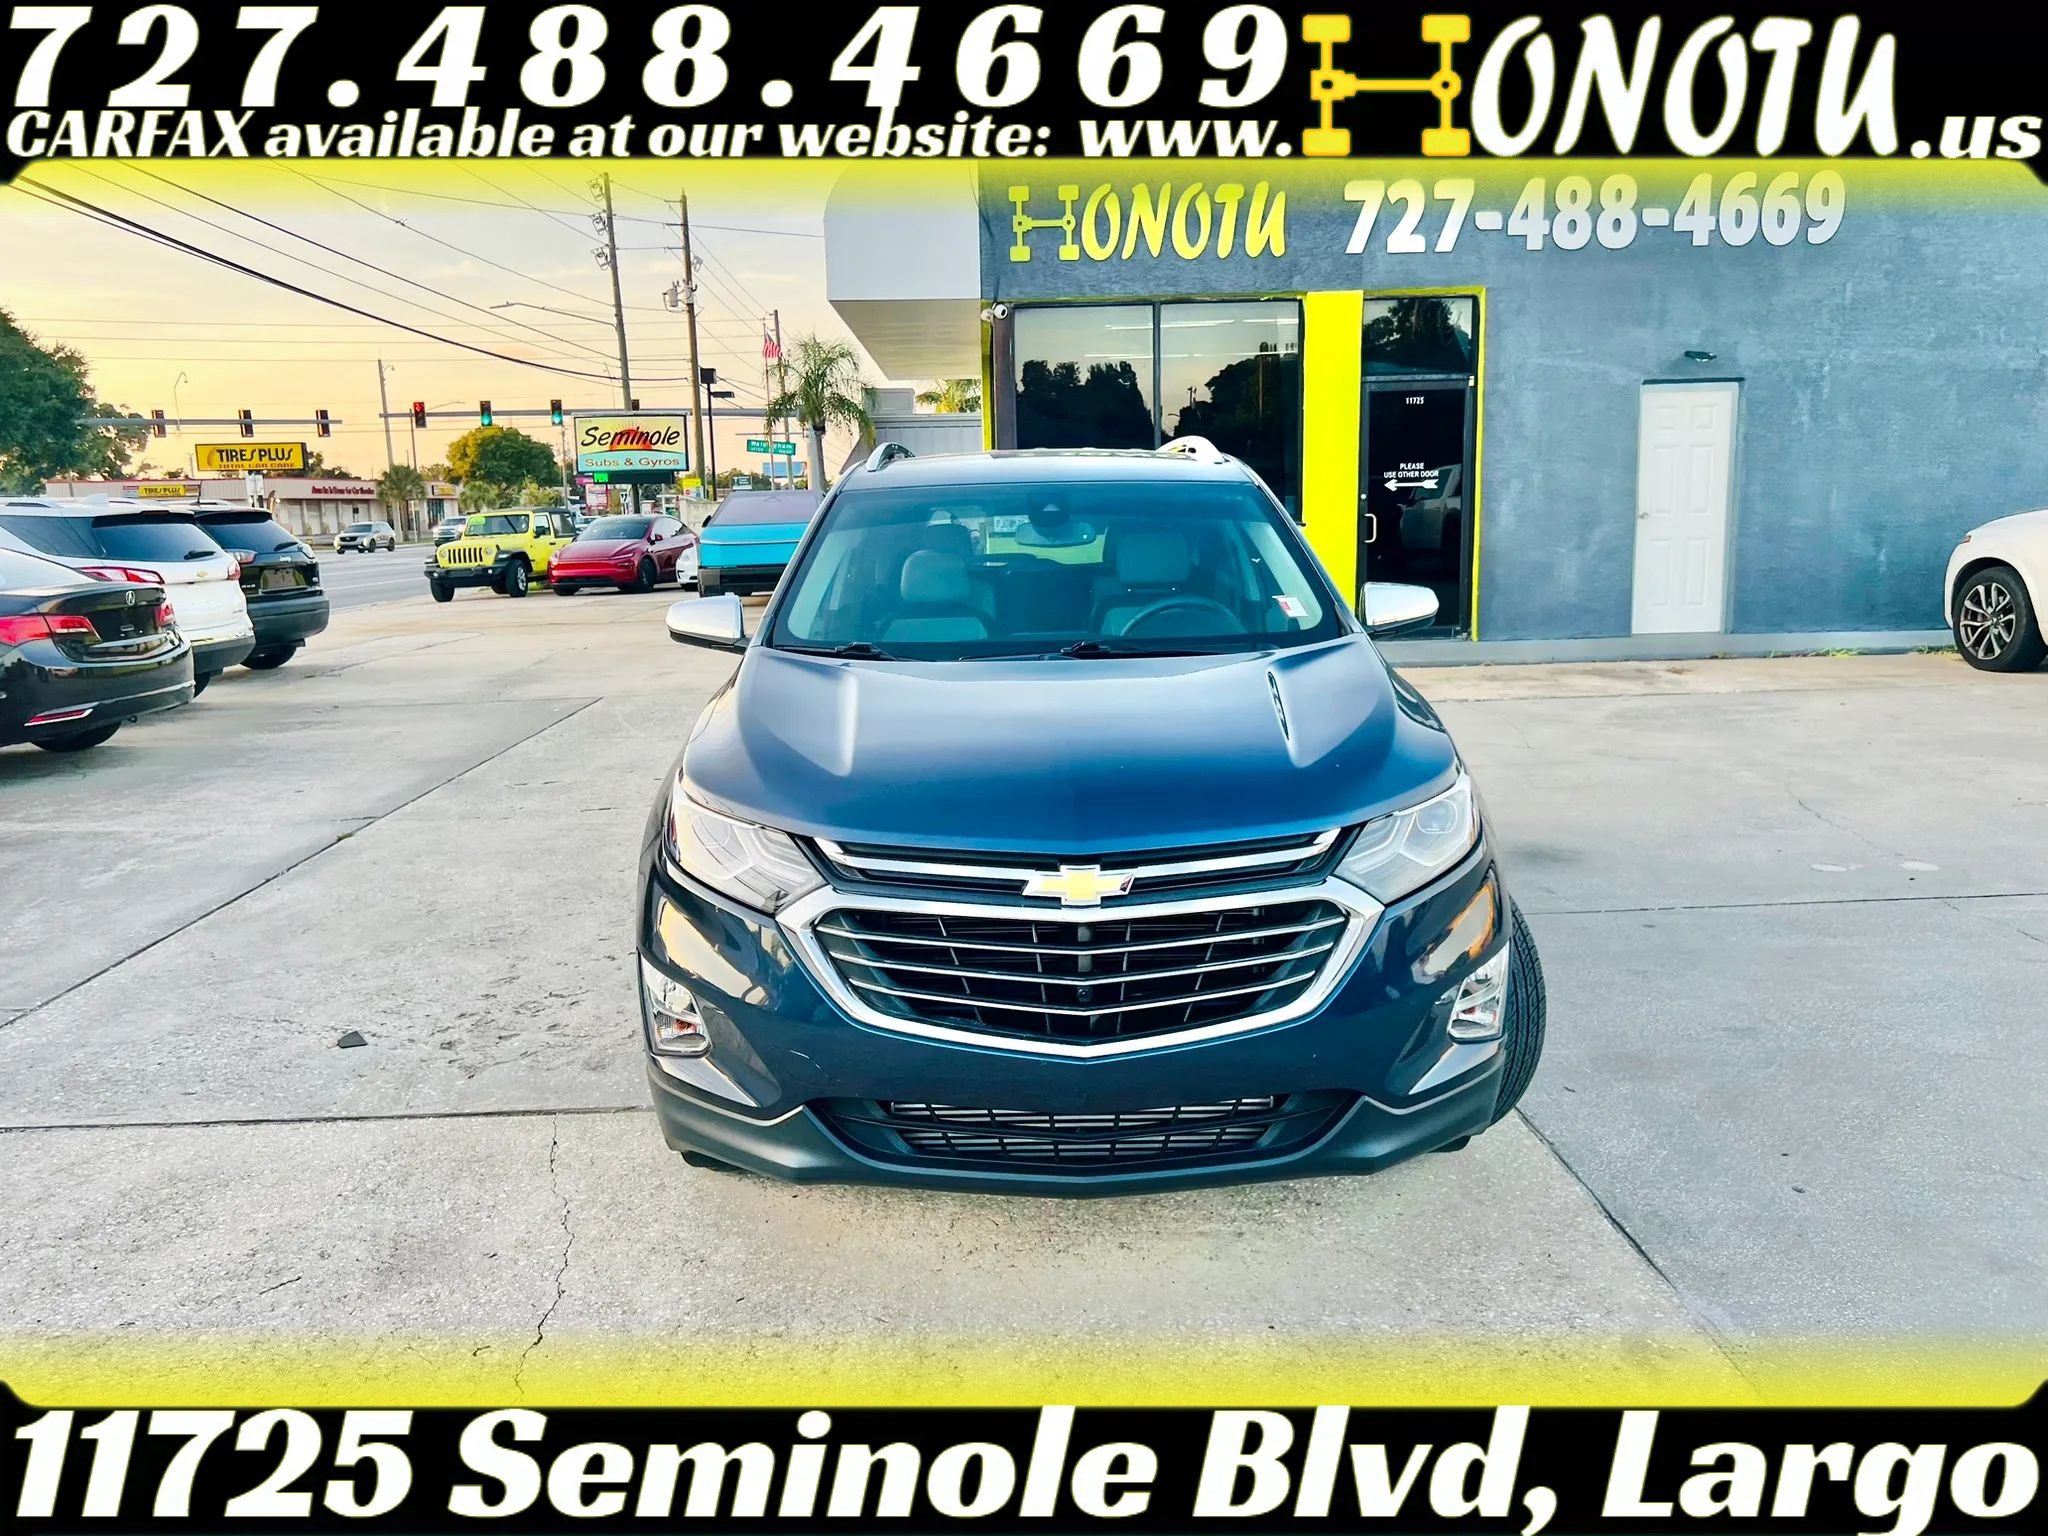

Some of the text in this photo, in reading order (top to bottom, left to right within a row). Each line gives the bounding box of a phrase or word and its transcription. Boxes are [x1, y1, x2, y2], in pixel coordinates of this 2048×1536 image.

[1342, 170, 1847, 255] 727-488-4669
[1405, 396, 1425, 405] 11725
[581, 425, 681, 447] Seminole
[216, 447, 293, 463] TIRES PLUS
[585, 457, 681, 468] Subs & Gyros
[1399, 462, 1425, 470] PLEASE
[1397, 470, 1420, 478] OTHER
[1420, 470, 1439, 478] DOOR
